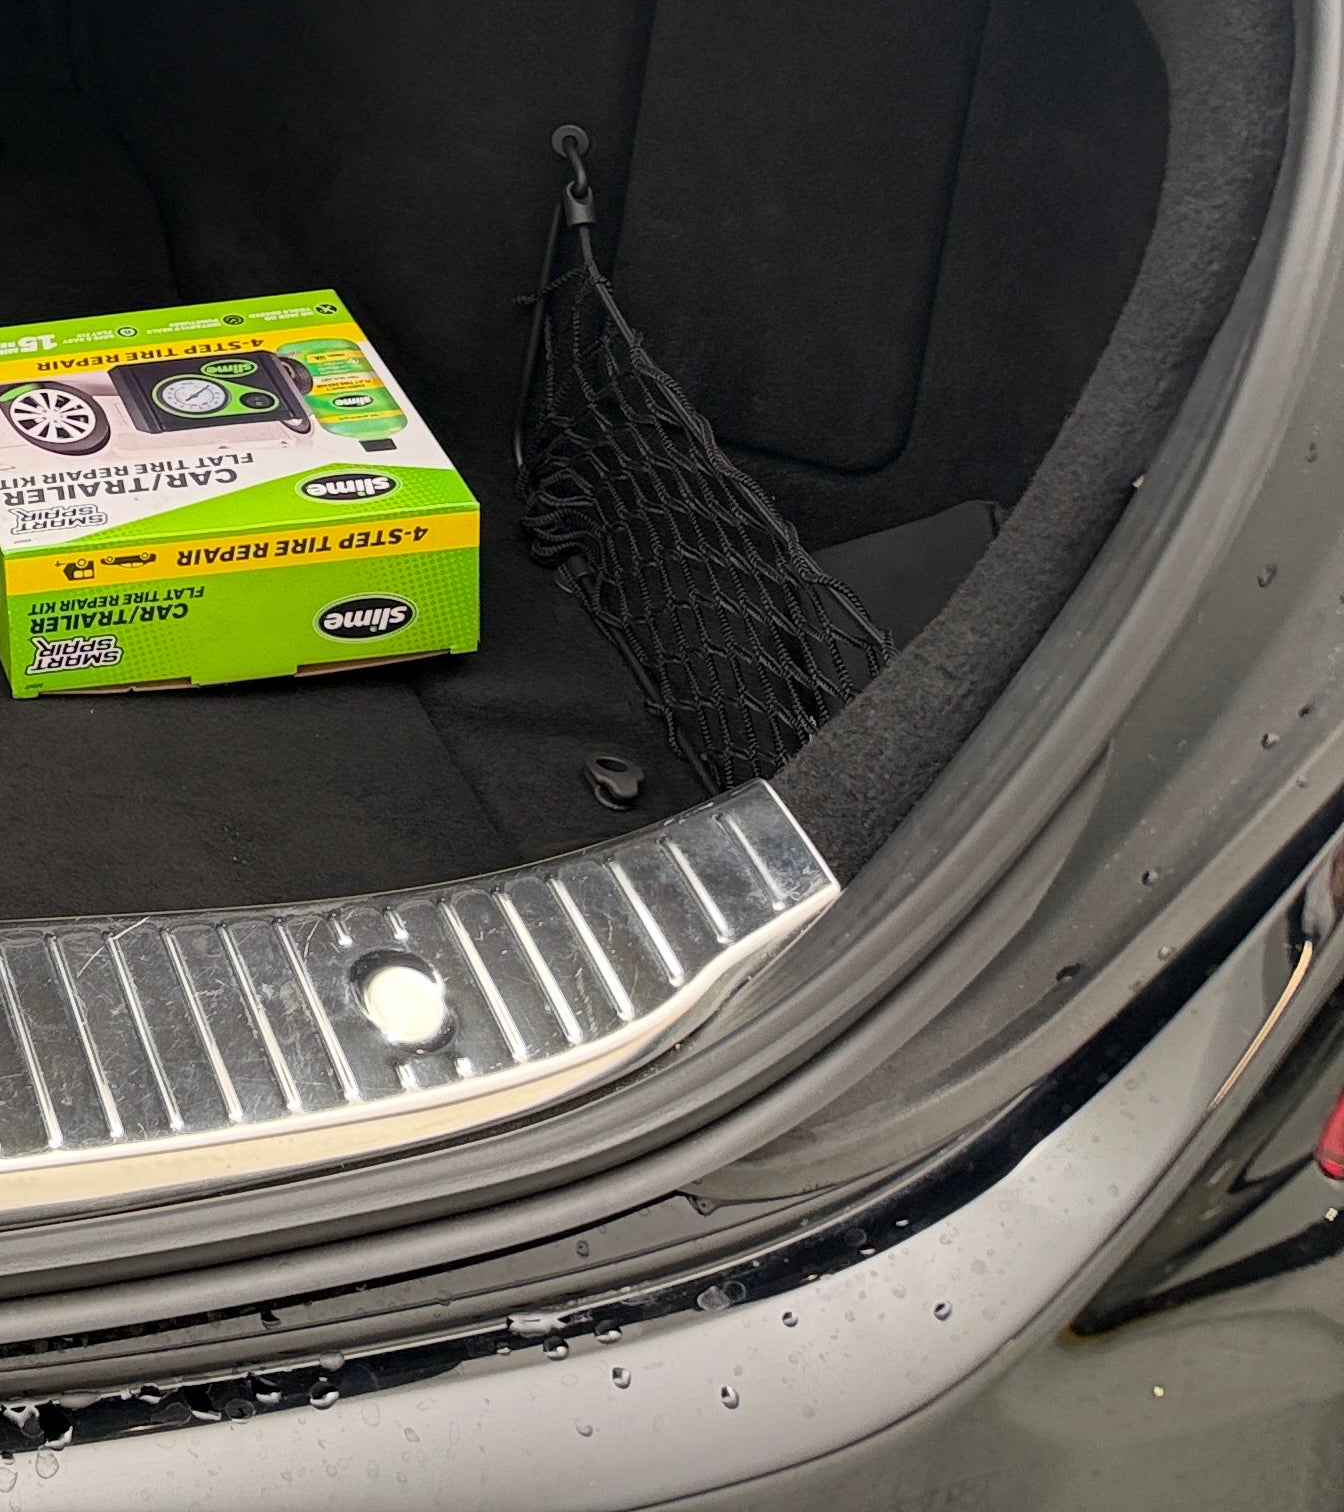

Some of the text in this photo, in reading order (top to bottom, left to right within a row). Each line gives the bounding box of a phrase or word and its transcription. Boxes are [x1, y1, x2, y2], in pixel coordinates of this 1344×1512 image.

[18, 334, 58, 353] 15
[37, 338, 264, 371] 4-STEP TIRE REPAIR
[206, 363, 252, 374] slime
[334, 396, 372, 406] slime
[134, 460, 190, 474] TIRE
[192, 452, 254, 468] FLAT
[43, 465, 128, 485] REPAIR
[4, 469, 238, 507] CAR/TRAILER
[306, 476, 390, 497] slime
[14, 507, 93, 521] SPAIR
[17, 514, 105, 532] SMART
[176, 526, 429, 567] 4-STEP TIRE REPAIR
[28, 586, 205, 616] FLAT TIRE REPAIR KIT
[30, 603, 189, 634] CAR/TRAILER
[323, 606, 408, 632] slime
[37, 638, 113, 657] SPAIR
[31, 650, 119, 671] SMART
